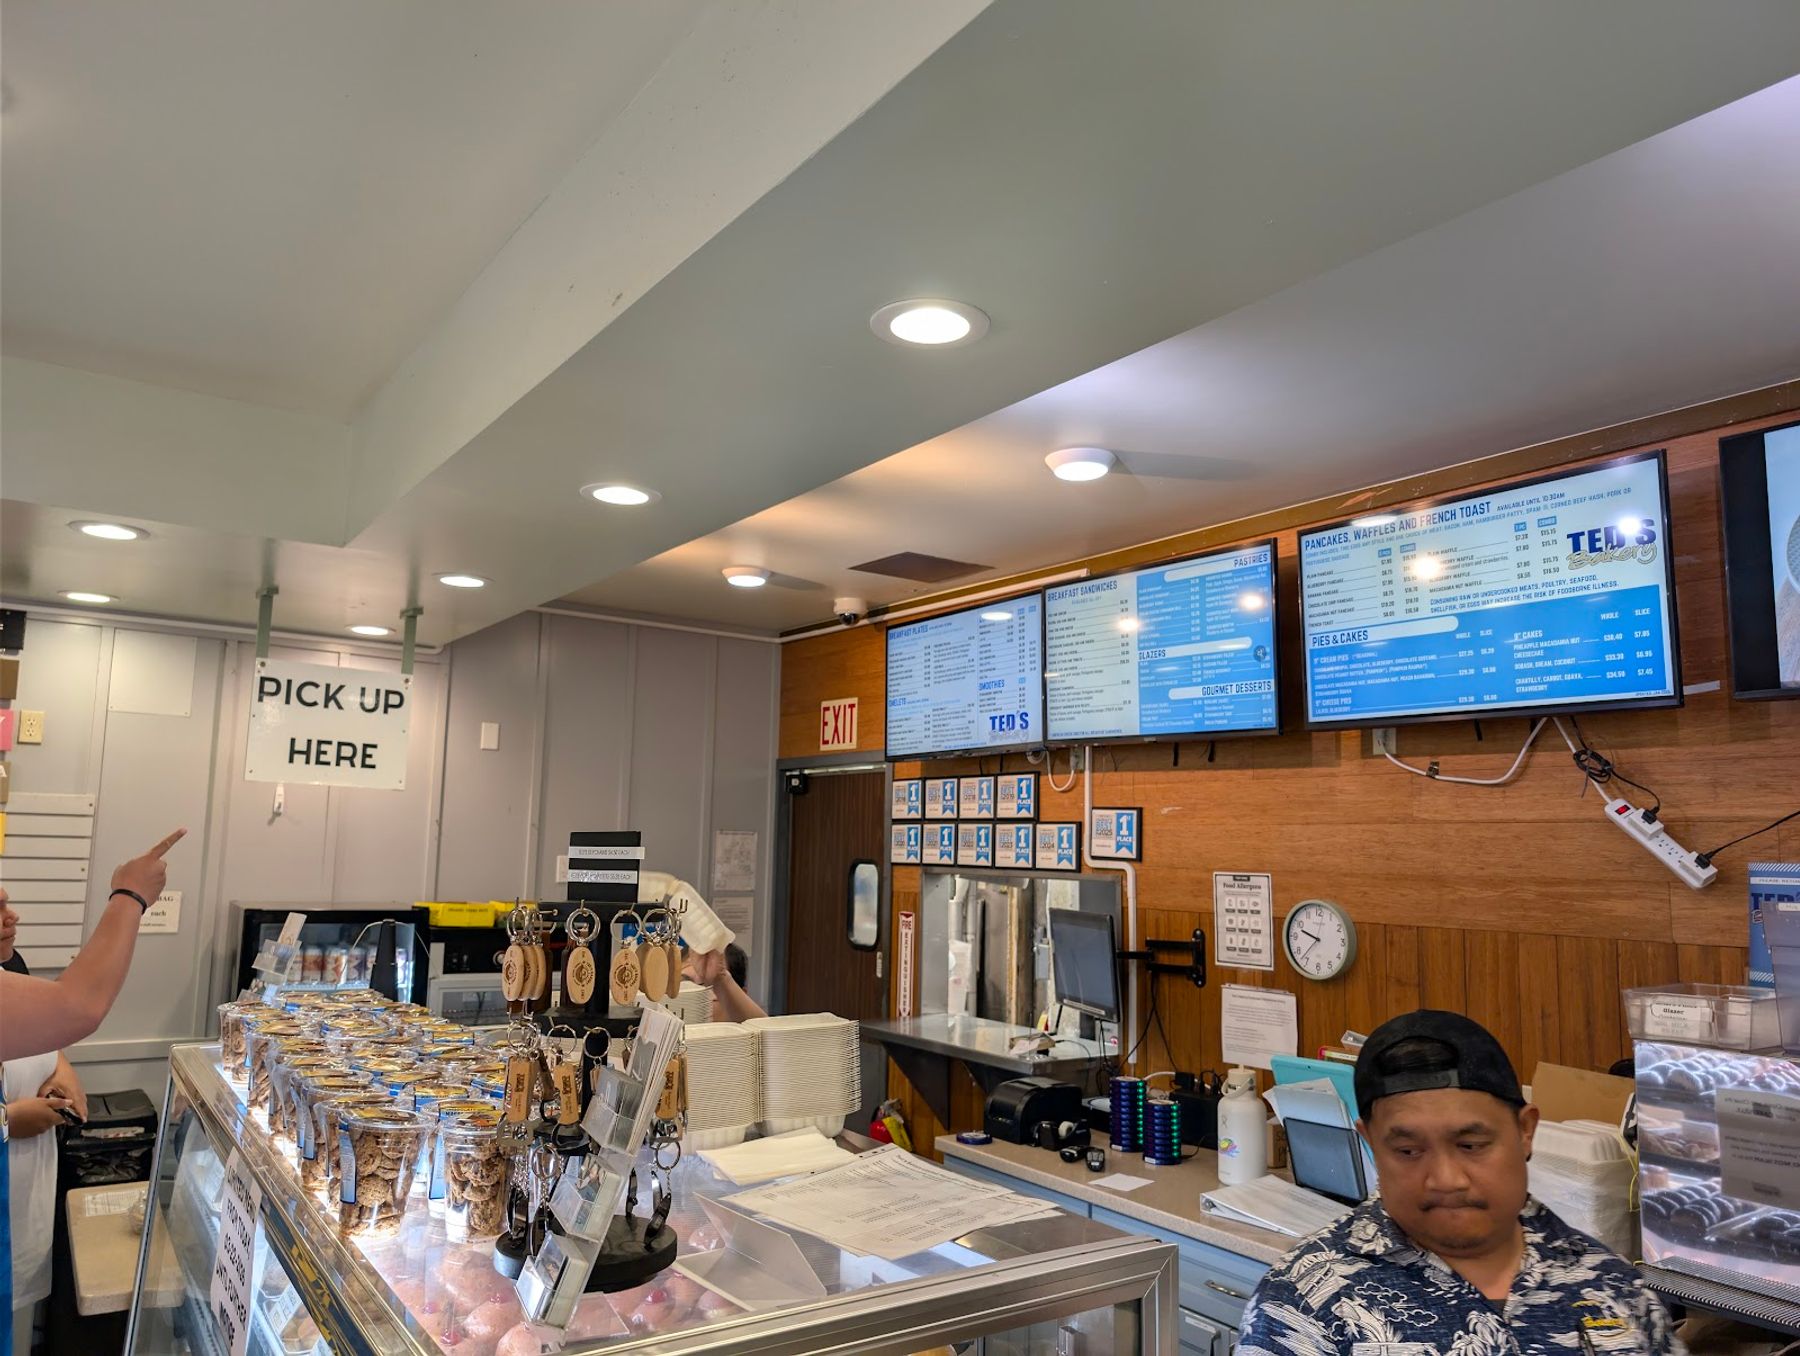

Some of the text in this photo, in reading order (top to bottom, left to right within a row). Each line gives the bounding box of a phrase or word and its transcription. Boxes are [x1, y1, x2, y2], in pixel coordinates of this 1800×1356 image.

[1496, 500, 1524, 511] AVAILABLE
[1526, 497, 1540, 505] UNTIL
[1305, 501, 1490, 550] PANCAKES, WAFFLES AND FRENCH TOAST
[1566, 518, 1657, 554] TEDS
[1234, 553, 1267, 567] PASTRIES
[1566, 543, 1657, 570] Bakery
[1047, 580, 1117, 601] BREAKFAST SANDWICHES
[1430, 596, 1458, 604] CONSUMING
[1481, 586, 1517, 597] UNDERCOOKED
[1557, 584, 1590, 594] FOODBORNE
[1634, 607, 1649, 615] SLICE
[1312, 629, 1368, 646] PIES & CAKES
[1522, 629, 1542, 638] CAKES
[1513, 642, 1538, 650] PINEAPPLE
[1539, 638, 1569, 647] MACADAMIA
[1138, 649, 1165, 659] GLAZERS
[258, 676, 405, 714] PICK UP
[1202, 680, 1271, 695] GOURMET DESSERTS
[822, 703, 856, 745] EXIT
[288, 737, 378, 769] HERE
[1237, 883, 1261, 891] Allergens
[227, 1198, 239, 1226] FROM
[227, 1278, 247, 1331] FURTHER
